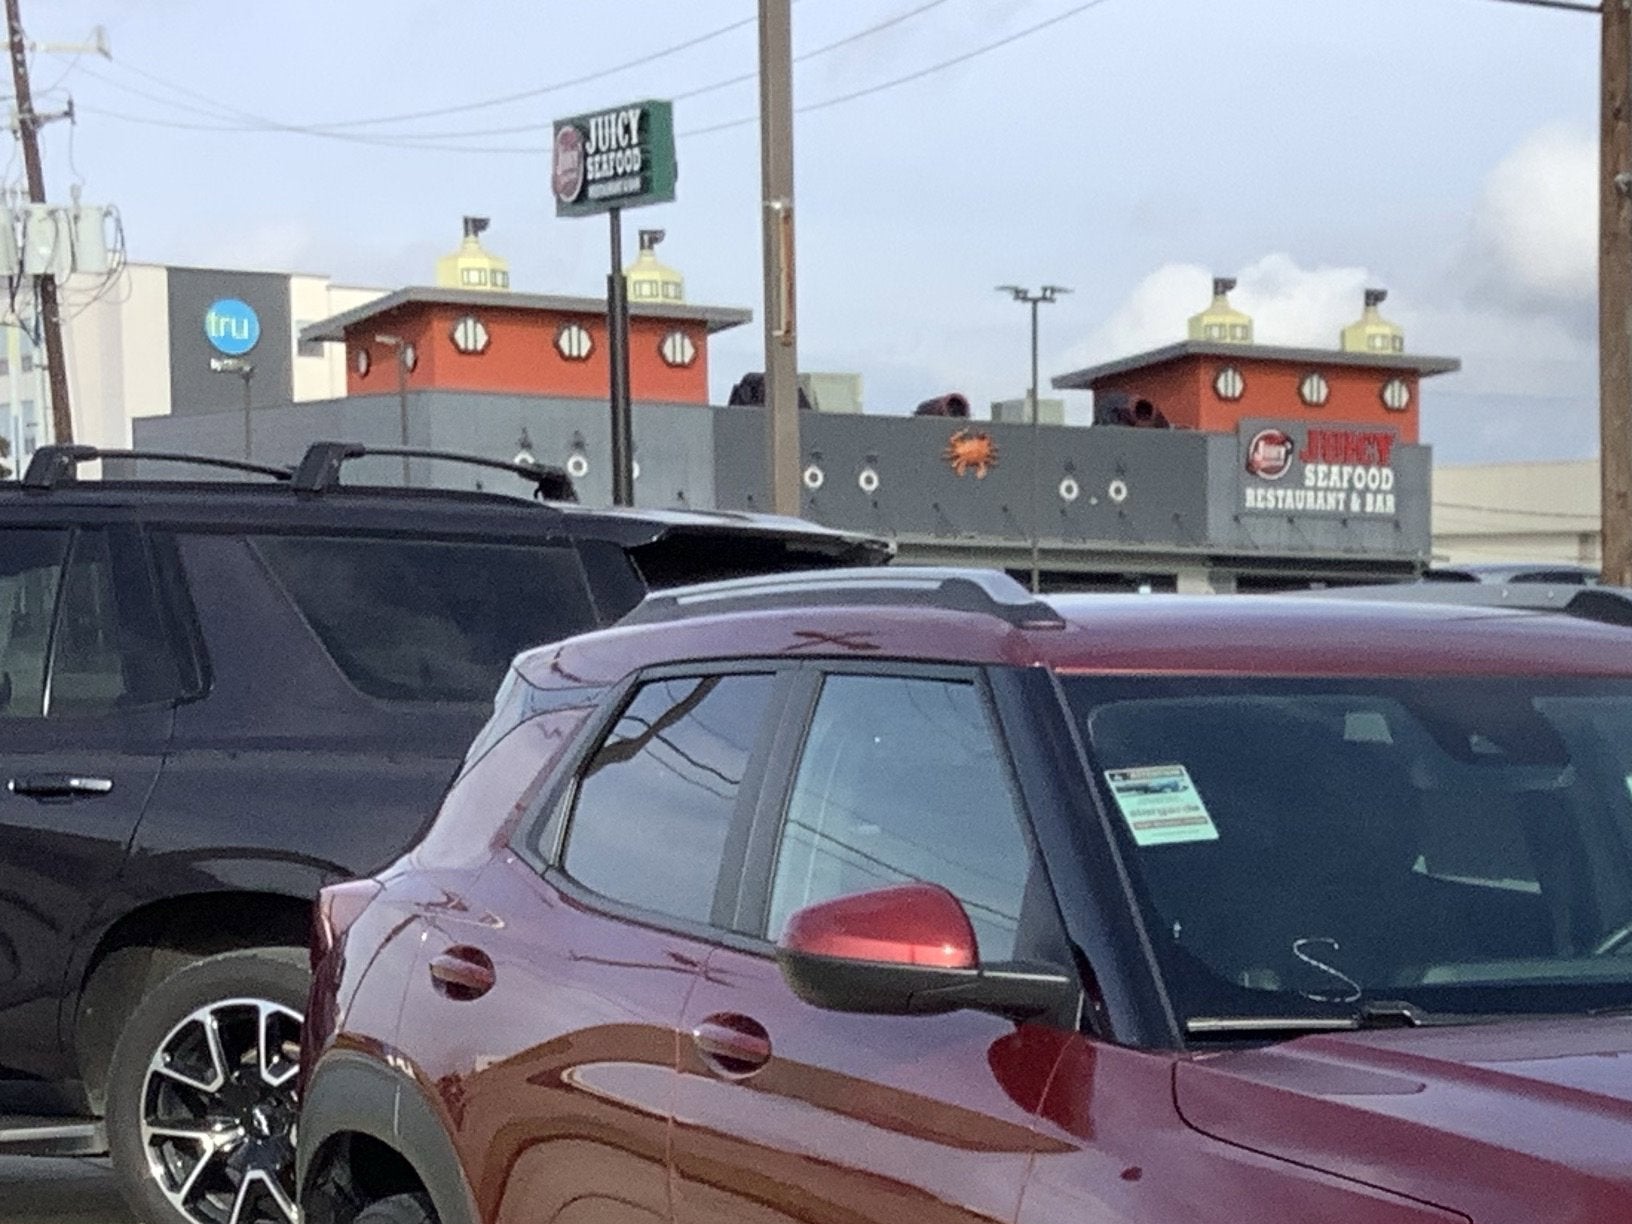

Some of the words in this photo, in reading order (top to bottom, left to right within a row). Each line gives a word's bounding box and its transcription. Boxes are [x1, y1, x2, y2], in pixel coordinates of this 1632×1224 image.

[585, 108, 642, 155] JUICY
[586, 146, 642, 181] SEAFOOD
[209, 311, 249, 340] tru
[1299, 429, 1396, 467] JUICY
[1304, 463, 1395, 491] SEAFOOD
[1245, 487, 1346, 512] RESTAURANT
[1364, 492, 1396, 514] BAR
